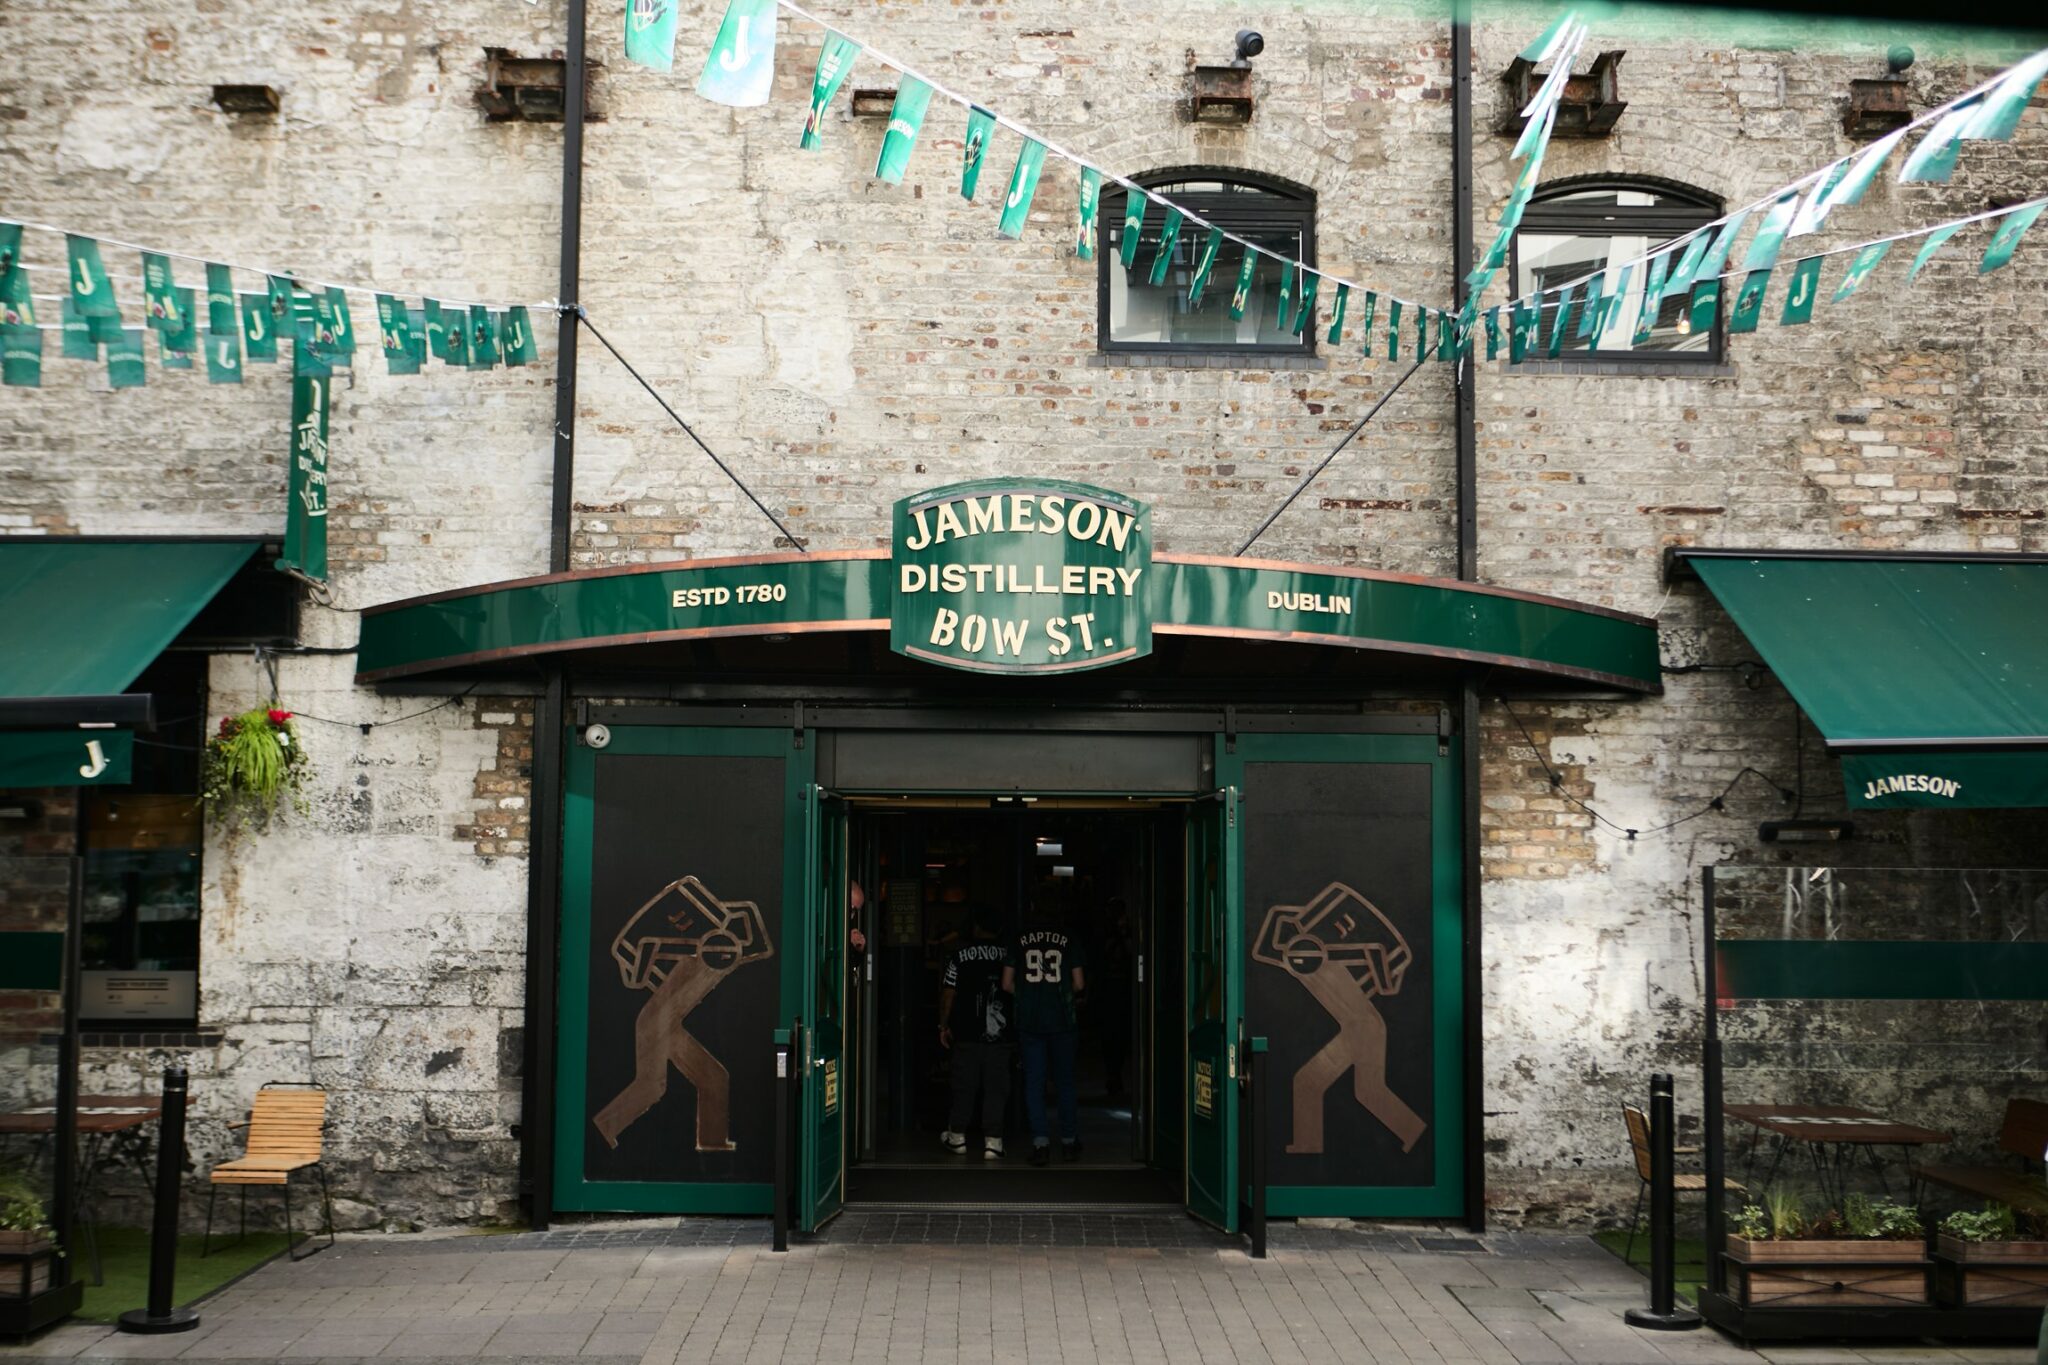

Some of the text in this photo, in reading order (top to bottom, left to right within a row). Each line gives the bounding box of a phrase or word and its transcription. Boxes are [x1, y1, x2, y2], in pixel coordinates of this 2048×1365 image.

[720, 15, 750, 72] J
[1008, 164, 1029, 208] J
[76, 258, 95, 295] J
[1792, 272, 1809, 307] J
[250, 310, 264, 341] J
[334, 304, 345, 336] J
[514, 321, 524, 349] J
[906, 494, 1135, 552] JAMESON
[673, 584, 787, 608] ESTD 1780
[901, 564, 1142, 596] DISTILLERY
[1267, 591, 1352, 615] DUBLIN
[930, 608, 1114, 656] BOW ST.
[79, 740, 107, 778] J
[1864, 774, 1959, 800] JAMESON
[1020, 932, 1068, 948] RAPTOR
[1025, 949, 1063, 983] 93
